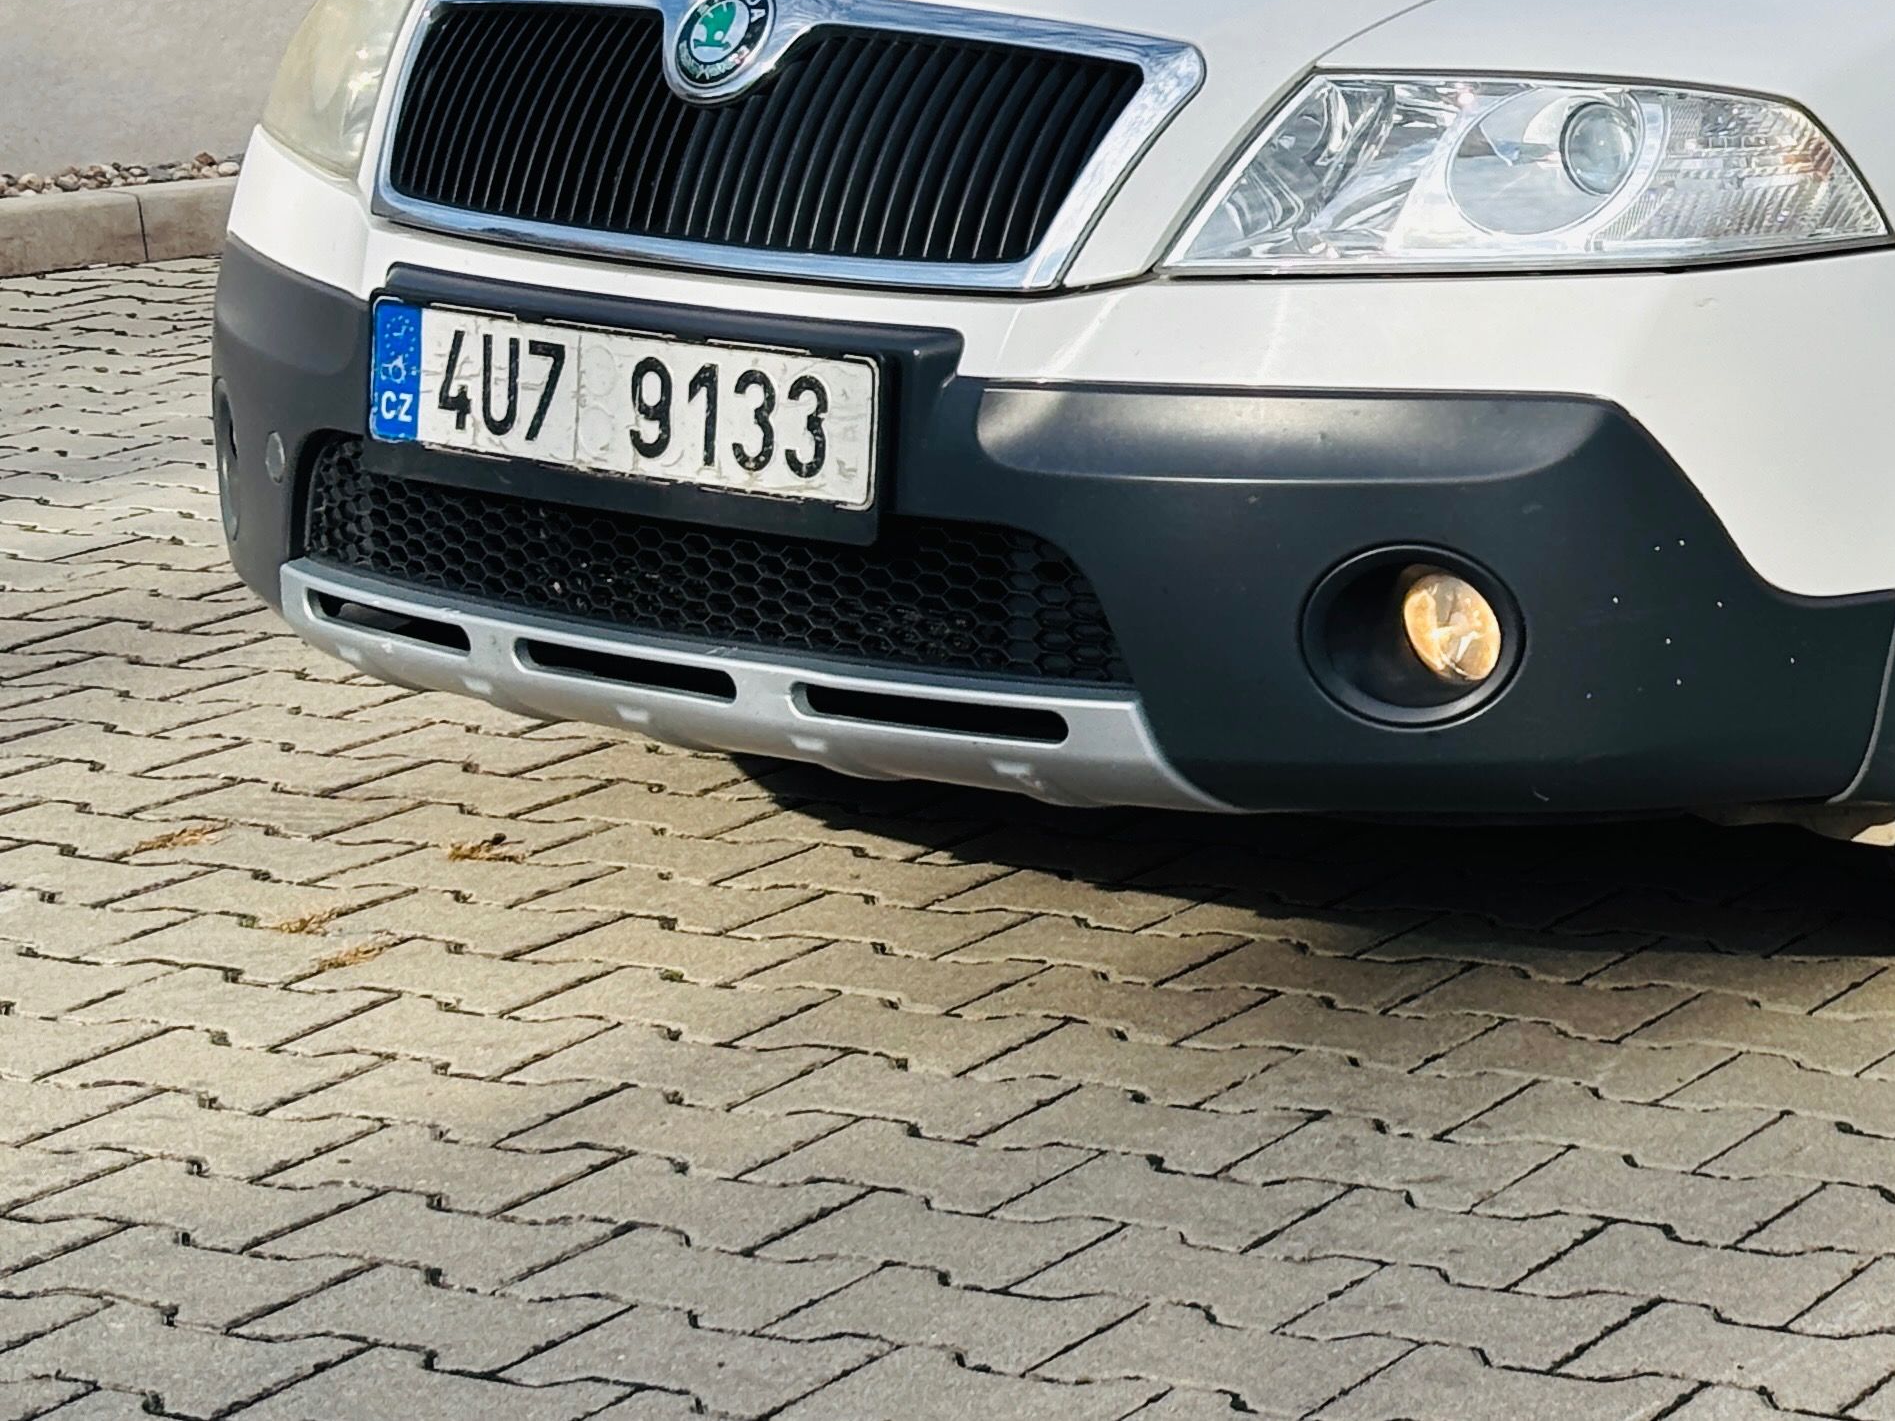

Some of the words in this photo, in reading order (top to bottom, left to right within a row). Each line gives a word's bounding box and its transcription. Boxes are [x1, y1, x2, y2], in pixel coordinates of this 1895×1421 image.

[381, 390, 413, 422] CZ
[437, 329, 566, 441] 4U7
[629, 357, 829, 478] 9133
